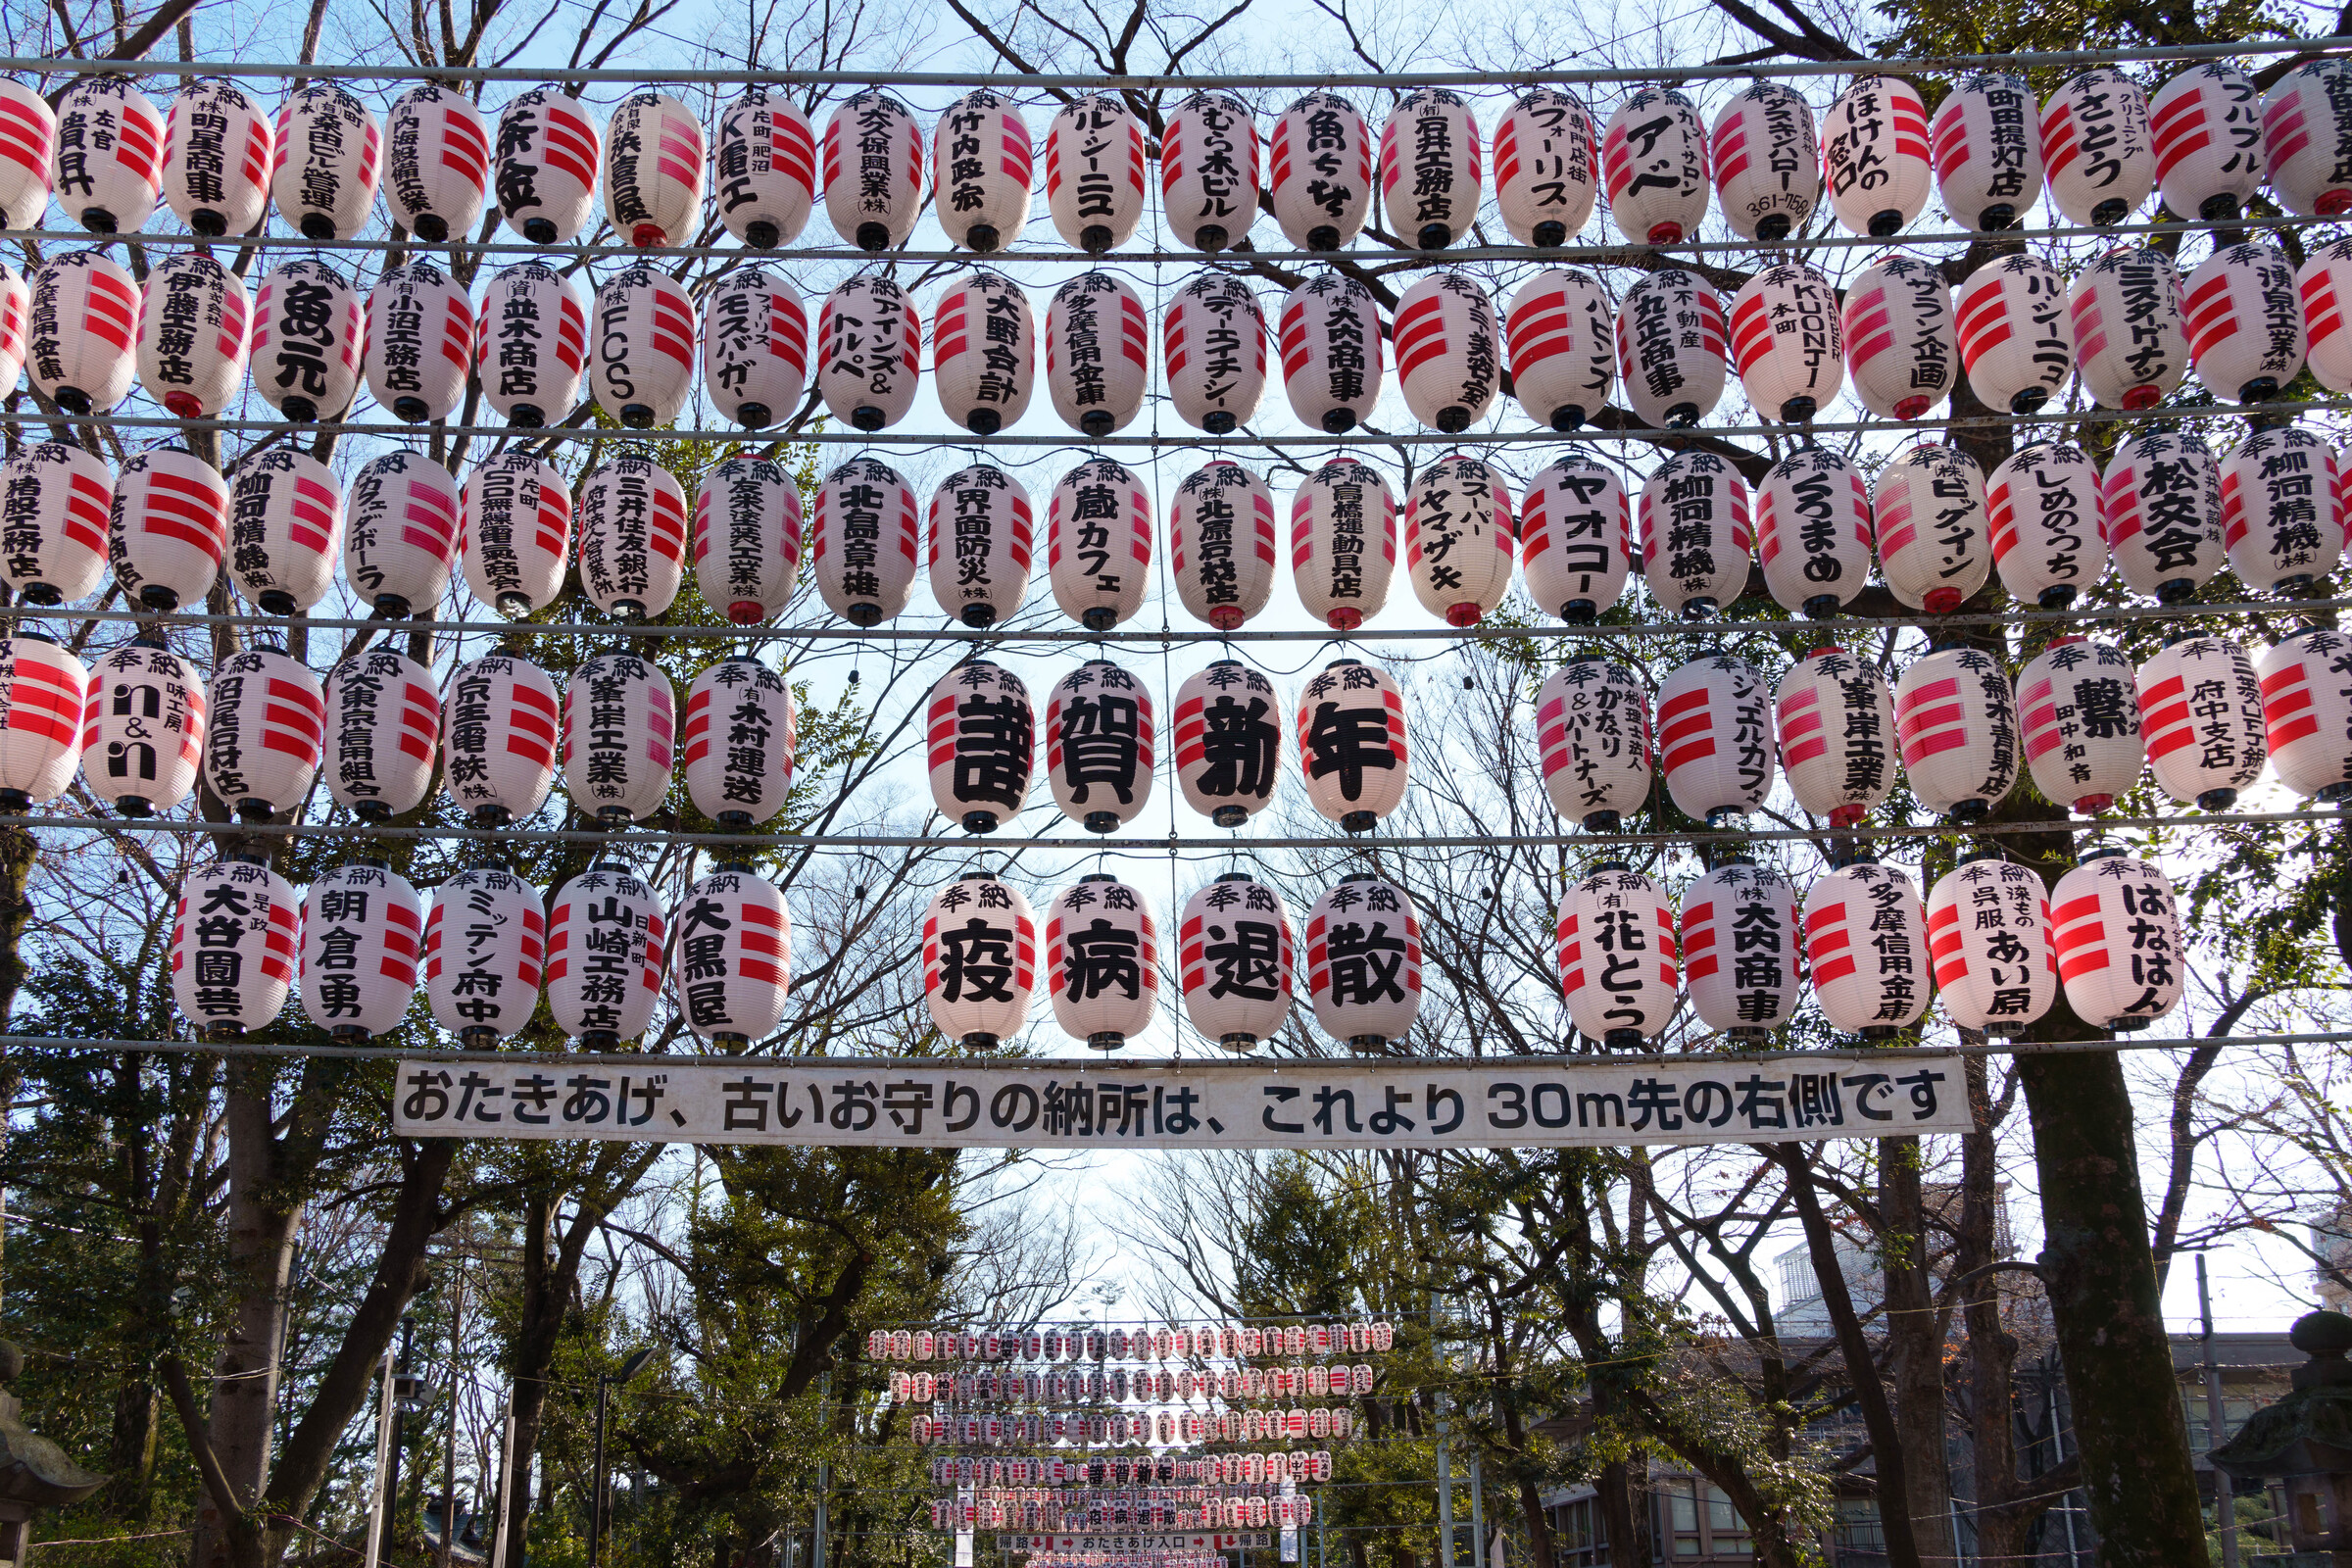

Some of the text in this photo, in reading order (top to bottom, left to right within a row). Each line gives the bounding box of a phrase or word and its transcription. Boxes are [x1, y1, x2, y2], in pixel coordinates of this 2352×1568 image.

[91, 110, 117, 151] 左官
[843, 92, 908, 118] 奉納
[1568, 113, 1588, 186] 専門店街
[1763, 96, 1799, 192] ダスキンハロー
[1985, 88, 2029, 198] 町田提灯店
[2073, 92, 2122, 190] さとう
[718, 112, 759, 214] K電工
[951, 111, 986, 213] 竹内政宏
[1197, 108, 1240, 218] むら木ビル
[1530, 107, 1568, 207] フォーリス
[1626, 116, 1681, 198] アベ
[30, 268, 68, 382] 多摩信用金庫
[156, 272, 207, 385] 伊藤工務店
[203, 279, 227, 330] 株式会社
[754, 293, 773, 347] フォーリス
[836, 275, 904, 300] 奉納
[1672, 289, 1702, 350] 不動産
[1769, 302, 1798, 335] 本町
[1792, 283, 1827, 389] KUONJI
[1821, 286, 1841, 364] BARBER
[1905, 277, 1950, 391] サラン企画
[2160, 266, 2180, 319] フォーリス
[716, 293, 758, 398] モスバーガー
[976, 295, 1021, 404] 大野会計
[1064, 294, 1107, 406] 多摩信用金庫
[1203, 295, 1244, 408] ディーエイチシー
[1633, 294, 1687, 399] 丸正商事
[941, 467, 1010, 494] 奉納
[1063, 463, 1131, 488] 奉納
[1459, 480, 1494, 536] スーパー
[2034, 468, 2083, 580] しめのうち
[2138, 457, 2203, 573] 松交会
[584, 484, 617, 601] 府中法人営業所
[613, 475, 651, 596] 三井住友銀行
[838, 484, 885, 600] 北島章雄
[1071, 484, 1122, 594] 蔵カフェ
[1328, 481, 1366, 600] 高橋運動具店
[1419, 488, 1464, 592] ヤマザキ
[1559, 474, 1609, 594] ヤオコー
[1791, 471, 1843, 582] くろまめ
[107, 647, 186, 679] 奉納
[163, 681, 188, 734] 味工房
[1061, 666, 1136, 692] 奉納
[1309, 665, 1380, 700] 奉納
[208, 676, 250, 797] 沼尾石材店
[336, 674, 384, 797] 大東京信用組合
[1594, 685, 1625, 759] かなり
[1623, 689, 1643, 773] 税理士法人
[1731, 674, 1767, 806] ジュエルカフェ
[2188, 678, 2236, 770] 府中支店
[248, 892, 272, 934] 是政
[576, 872, 650, 902] 奉納
[939, 883, 1013, 913] 奉納
[1063, 884, 1139, 912] 奉納
[1205, 883, 1277, 913] 奉納
[1327, 885, 1401, 913] 奉納
[1971, 885, 2007, 932] 呉服
[194, 884, 252, 1017] 大谷園芸
[315, 889, 370, 1019] 朝倉勇
[451, 888, 509, 1023] ミッテン府中
[577, 895, 634, 1030] 山崎工務店
[630, 912, 650, 968] 日新町
[682, 897, 734, 1027] 大黒屋
[1868, 882, 1916, 1023] 多摩信用金庫
[1984, 929, 2033, 1017] あい原
[2121, 882, 2176, 1014] はなはん
[999, 1536, 1030, 1550] 帰路
[1082, 1535, 1186, 1550] おたきあげ入口
[1238, 1532, 1269, 1546] 帰路
